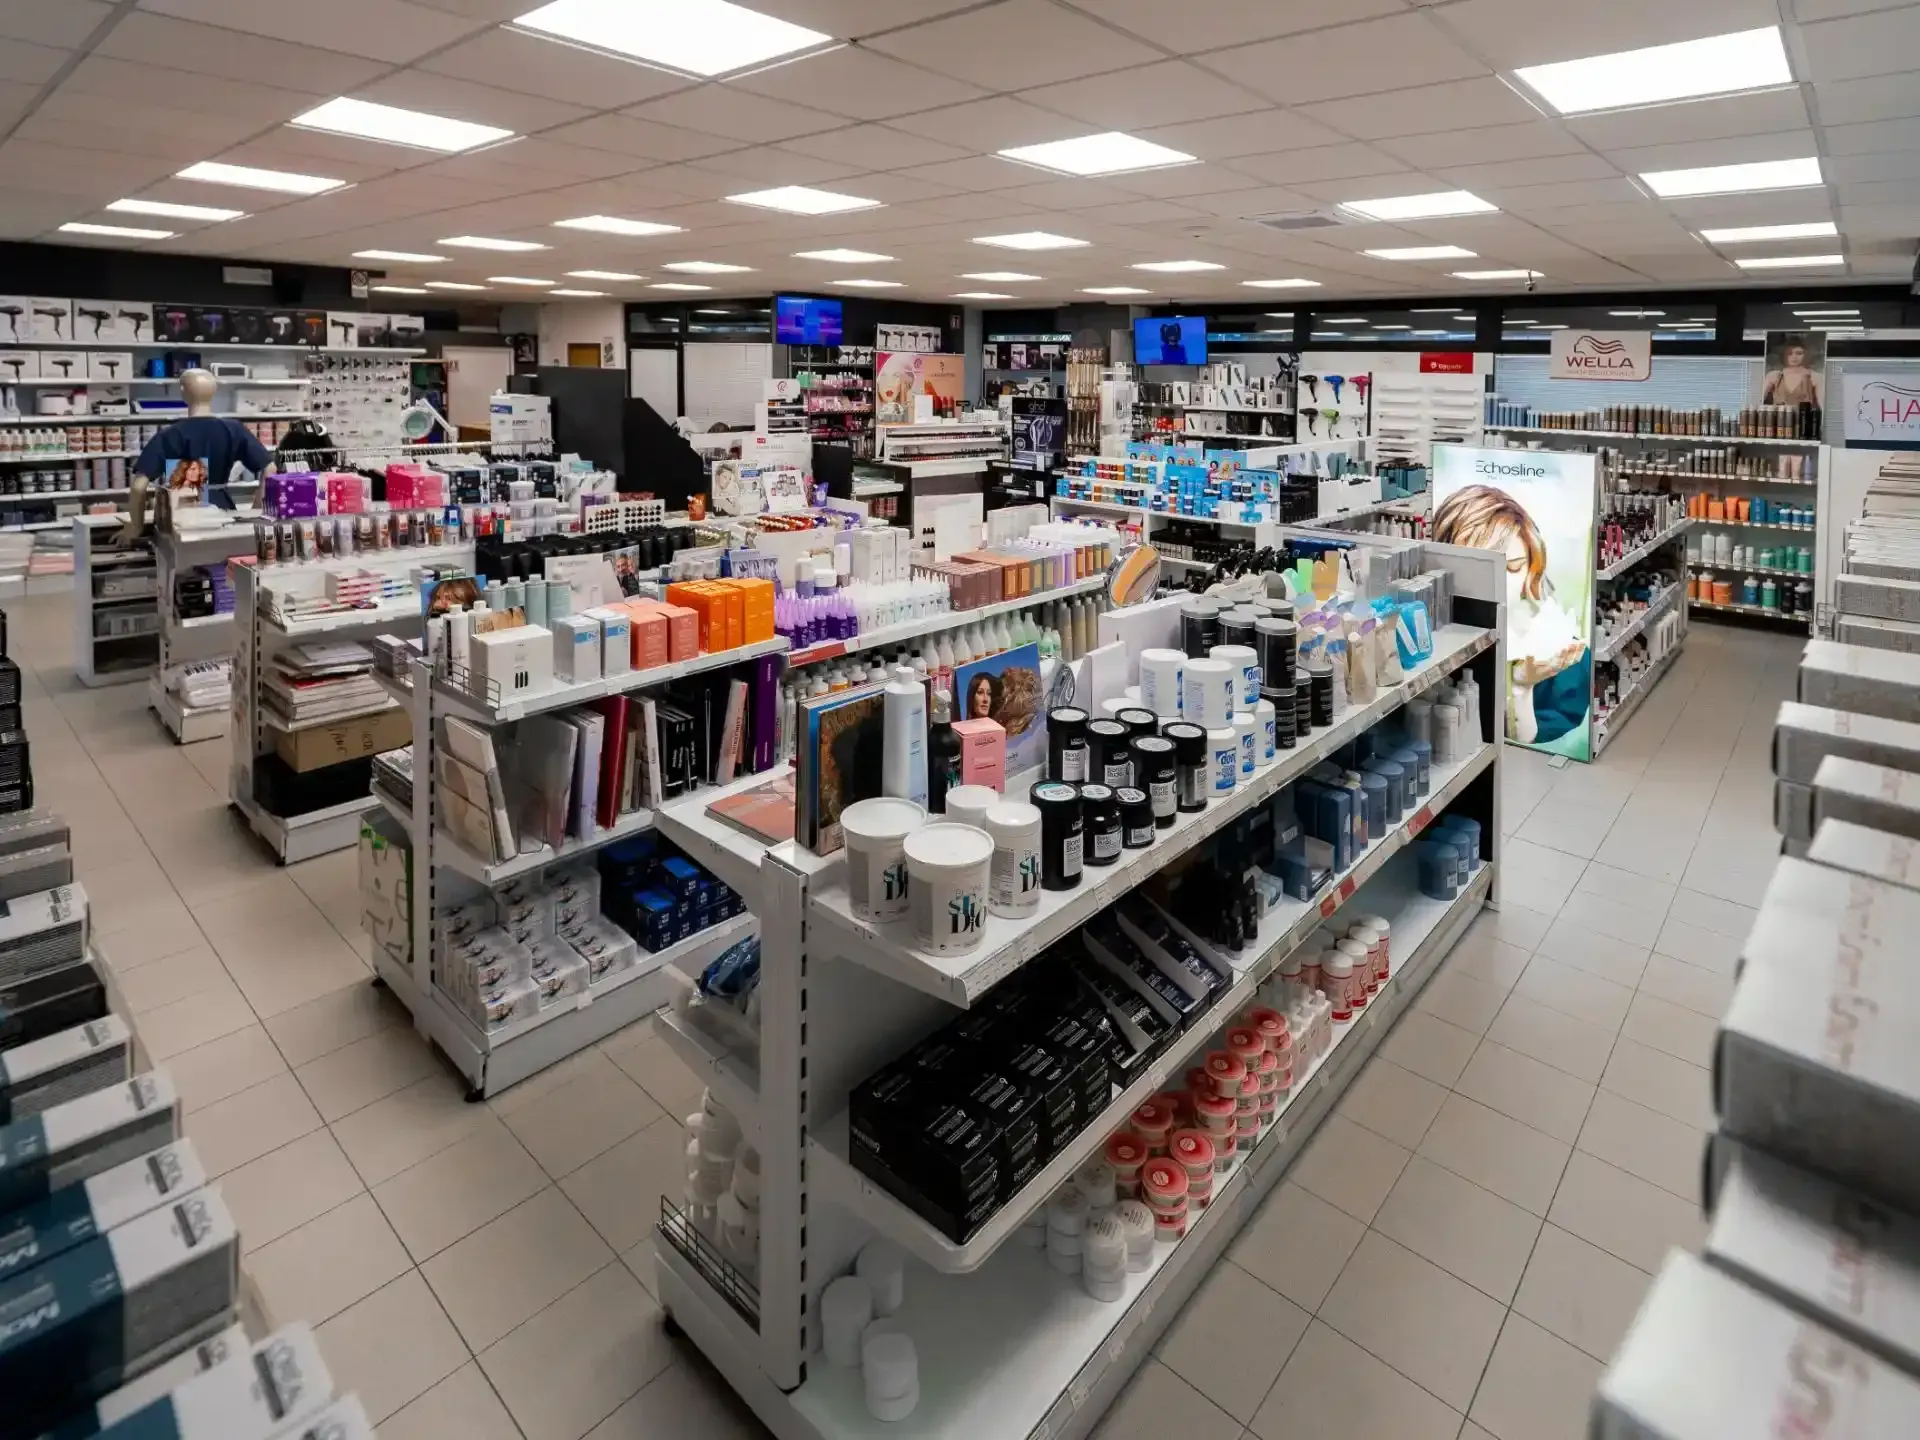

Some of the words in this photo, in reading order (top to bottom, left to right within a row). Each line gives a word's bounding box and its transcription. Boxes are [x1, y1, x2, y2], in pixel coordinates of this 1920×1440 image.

[1566, 356, 1635, 369] WELLA
[1028, 400, 1046, 413] ghd
[1475, 459, 1545, 477] Echosline
